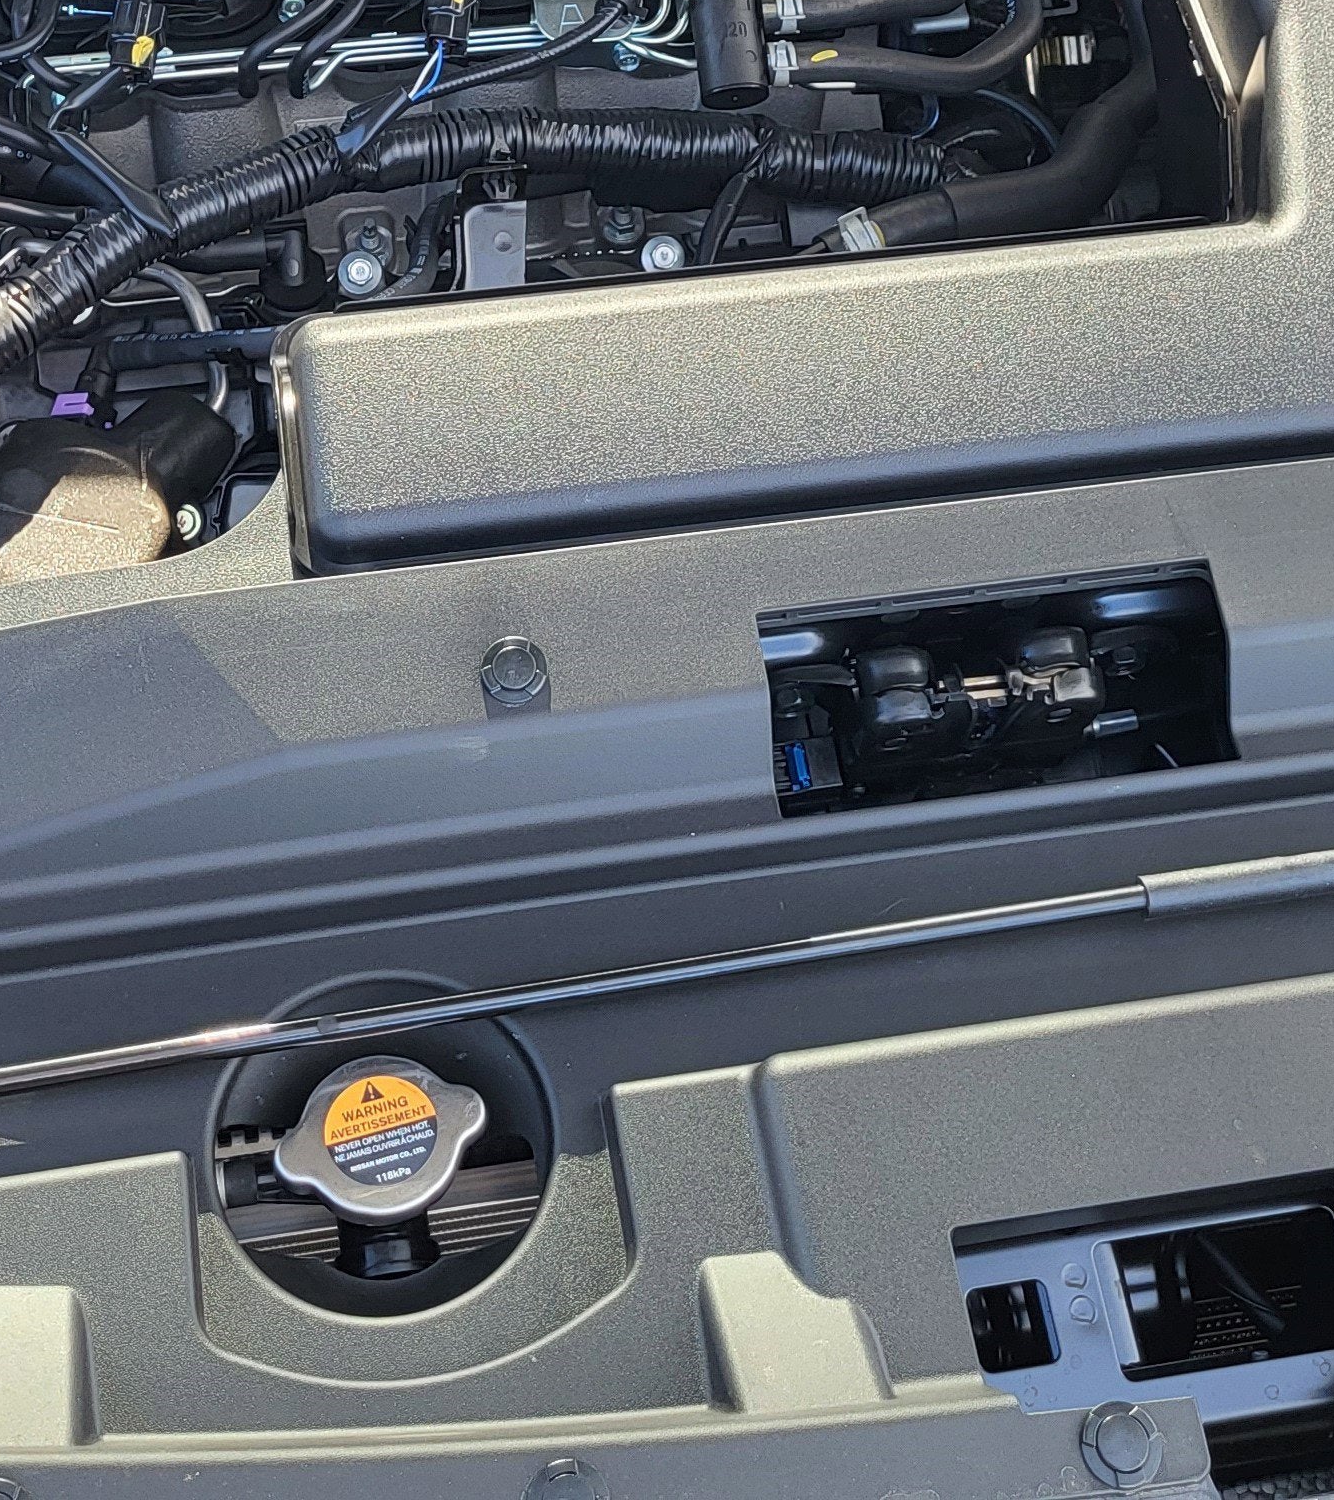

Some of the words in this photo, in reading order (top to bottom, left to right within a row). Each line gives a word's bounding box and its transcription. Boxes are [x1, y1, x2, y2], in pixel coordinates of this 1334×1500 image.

[558, 3, 586, 36] A
[330, 1104, 427, 1140] AVERTISSEMENT
[341, 1095, 409, 1122] WARNING
[335, 1140, 361, 1153] NEVER
[362, 1133, 384, 1145] OPEN
[385, 1126, 411, 1138] WHEN
[412, 1120, 430, 1131] HOT.
[335, 1154, 345, 1162] NE
[346, 1147, 372, 1159] JAMAIS
[372, 1139, 400, 1152] OUVRIR
[406, 1129, 435, 1142] CHAUD.
[350, 1160, 375, 1171] NISSAN
[376, 1154, 399, 1164] MOTOR
[413, 1146, 426, 1154] LTD.
[375, 1165, 412, 1183] 118kPa
